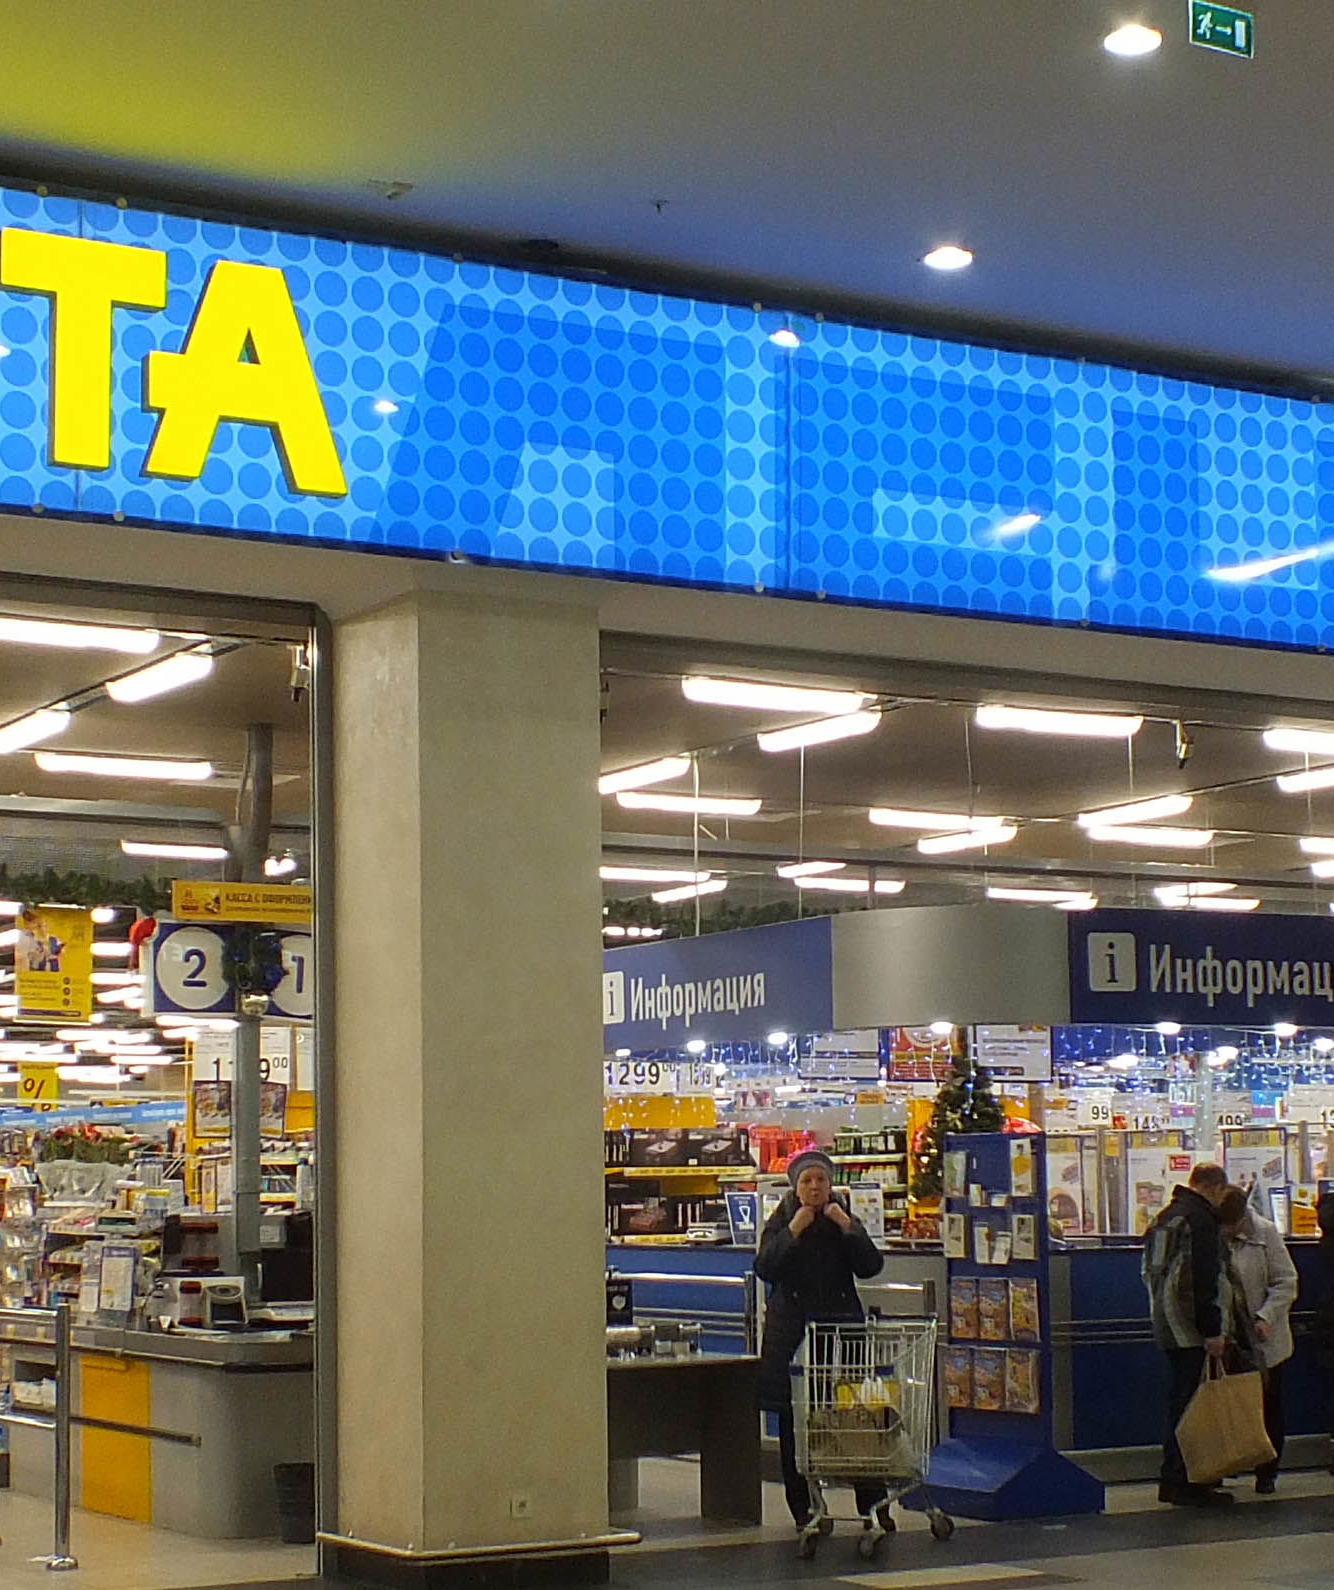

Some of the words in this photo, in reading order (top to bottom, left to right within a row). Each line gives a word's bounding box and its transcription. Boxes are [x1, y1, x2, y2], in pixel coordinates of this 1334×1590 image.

[182, 948, 207, 987] 2
[291, 955, 304, 994] 1
[630, 972, 765, 1031] Информация
[605, 1062, 660, 1086] 1299
